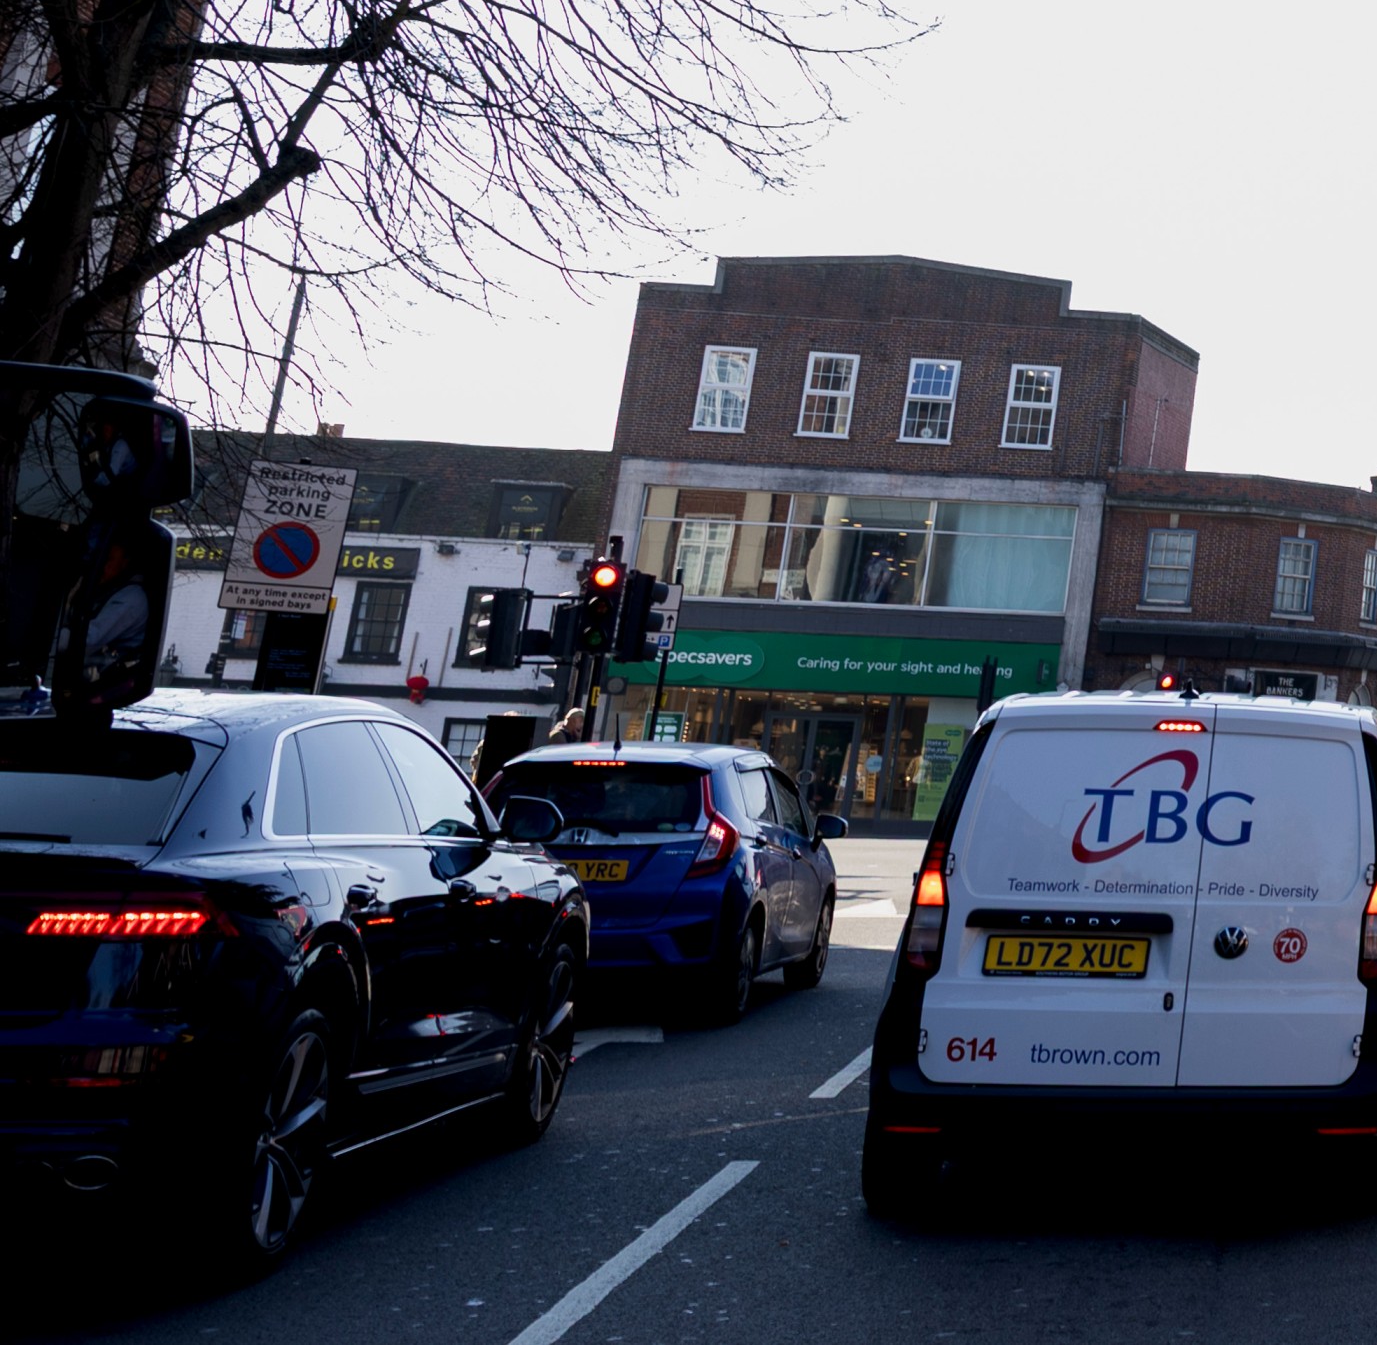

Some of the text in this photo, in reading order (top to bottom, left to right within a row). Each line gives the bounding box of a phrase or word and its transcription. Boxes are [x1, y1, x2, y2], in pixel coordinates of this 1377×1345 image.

[260, 467, 346, 486] Restricted
[268, 484, 331, 502] parking
[264, 500, 327, 519] ZONE
[226, 585, 326, 603] At any time except
[236, 597, 311, 610] in signed bays
[660, 636, 668, 646] P
[797, 657, 1013, 679] Caring for your sight and heng
[1278, 677, 1295, 686] THE
[1266, 686, 1304, 697] BANKERS
[1083, 787, 1256, 848] TBG
[586, 862, 621, 878] YRC
[1008, 878, 1319, 901] Teamwork Determination Pride Diversity
[1021, 916, 1121, 926] CADDY
[996, 941, 1136, 968] LD72 XUC
[1280, 938, 1301, 954] 70
[946, 1037, 1160, 1066] 614 tbrown.com
